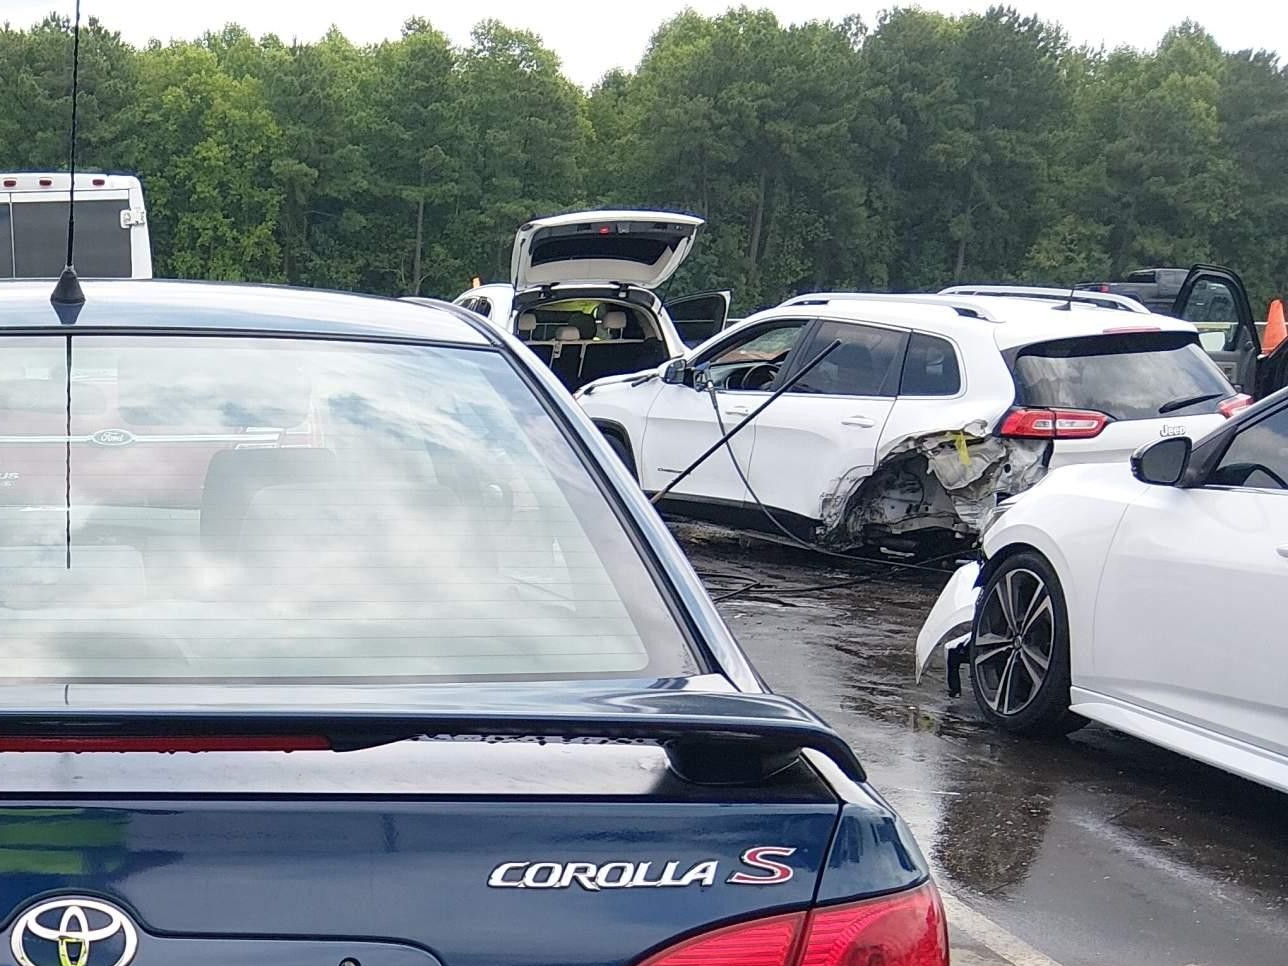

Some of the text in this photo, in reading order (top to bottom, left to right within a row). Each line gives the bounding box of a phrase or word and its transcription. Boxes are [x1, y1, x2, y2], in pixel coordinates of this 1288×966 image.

[101, 431, 124, 442] Ford
[1160, 425, 1186, 437] Jeep
[487, 846, 797, 891] COROLLA S
